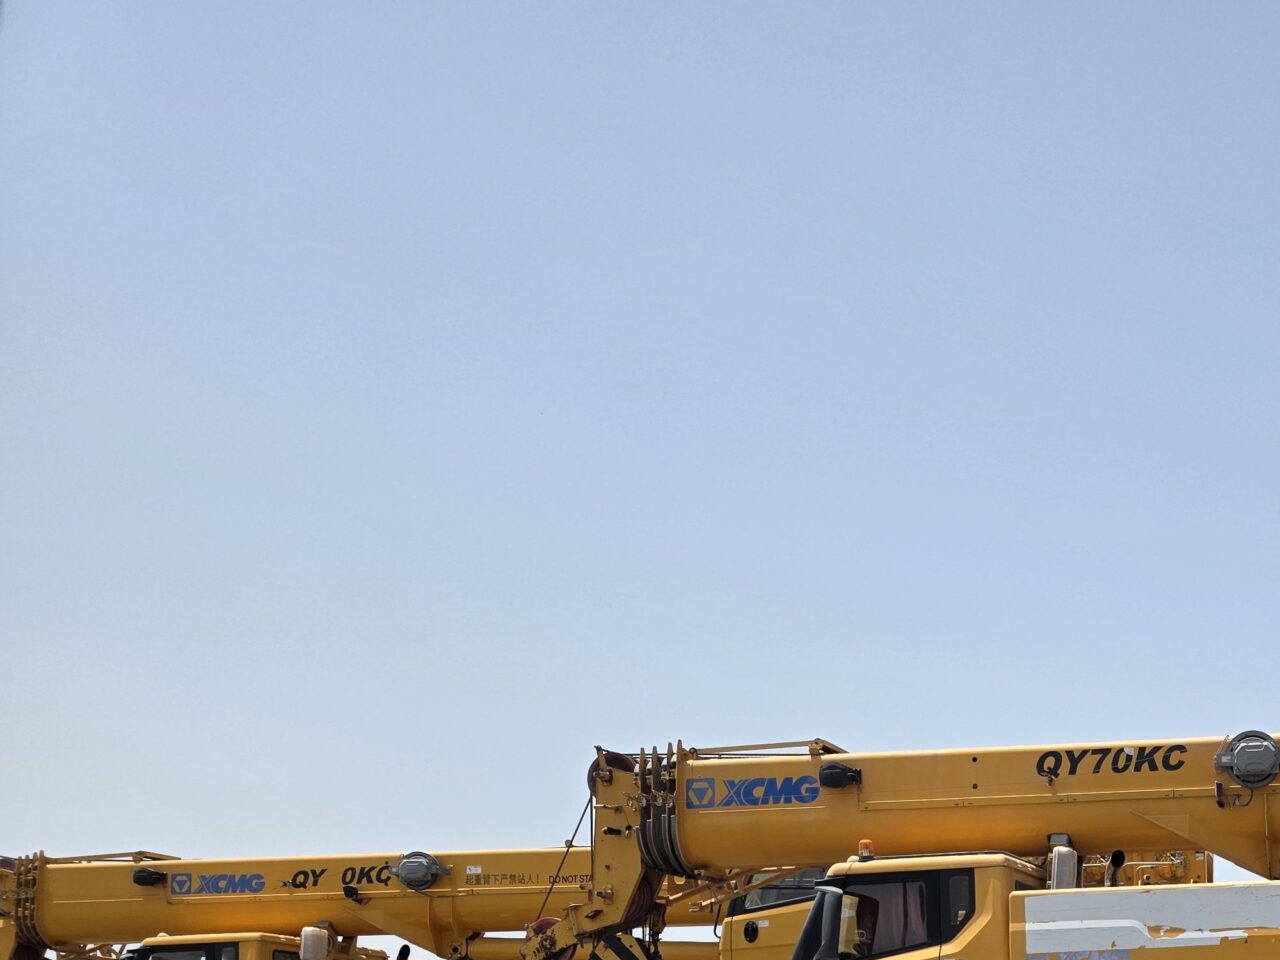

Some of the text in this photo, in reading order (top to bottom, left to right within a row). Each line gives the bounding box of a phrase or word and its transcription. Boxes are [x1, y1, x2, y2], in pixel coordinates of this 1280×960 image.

[1036, 744, 1188, 778] QY70KC
[716, 775, 821, 807] XCMG
[193, 873, 266, 895] XCMG
[561, 874, 578, 884] NOT
[579, 874, 593, 883] STA
